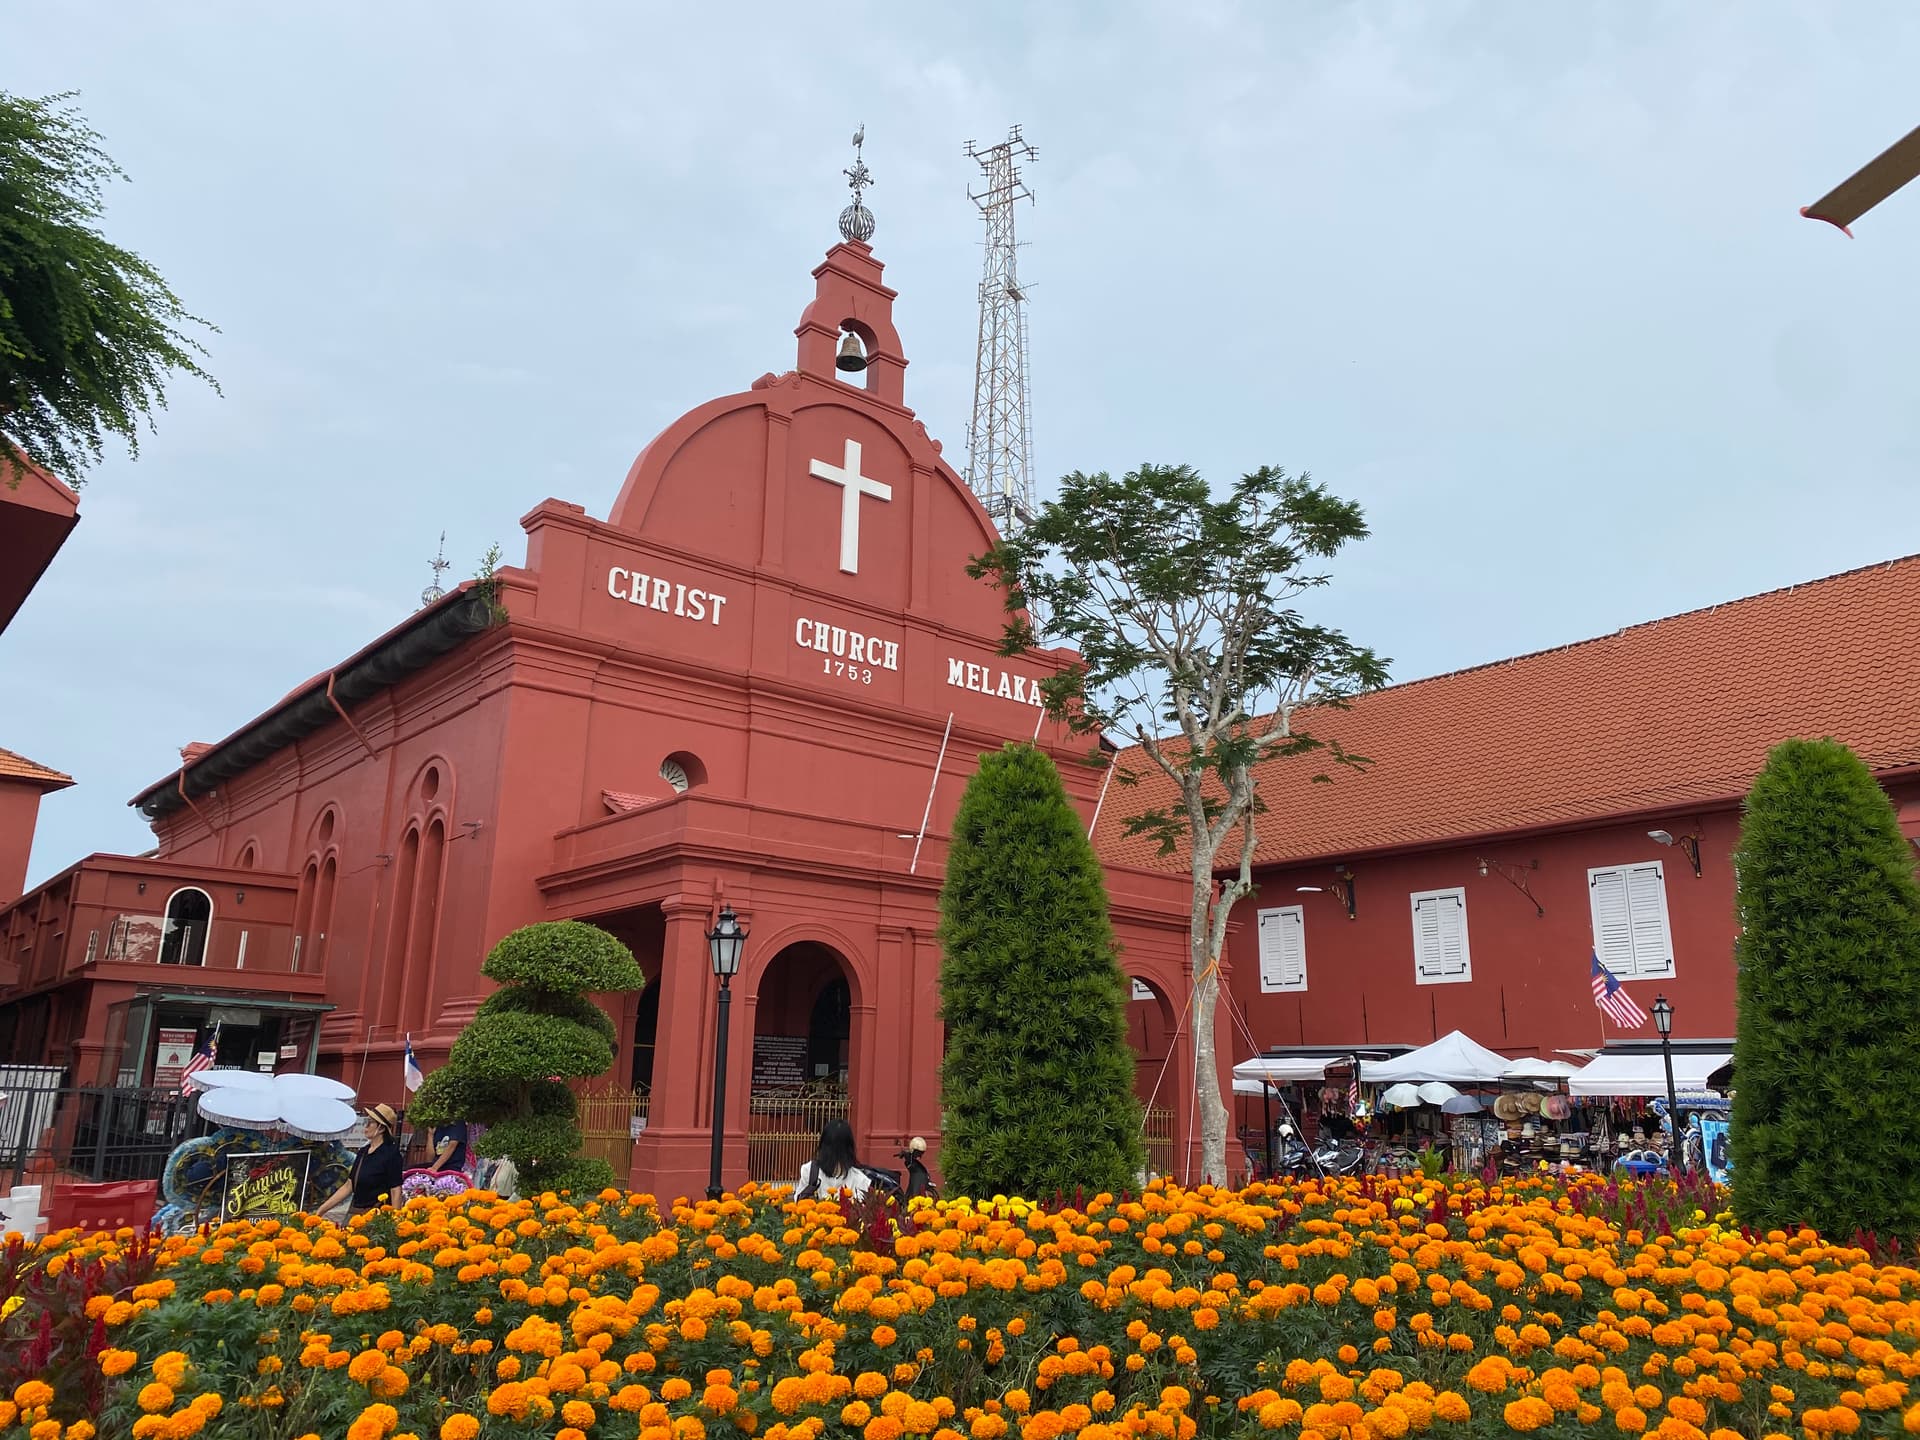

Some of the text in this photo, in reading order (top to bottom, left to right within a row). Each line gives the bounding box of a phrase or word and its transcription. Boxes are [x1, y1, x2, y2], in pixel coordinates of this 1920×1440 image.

[607, 566, 727, 625] CHRIST
[796, 617, 899, 671] CHURCH
[823, 658, 872, 685] 1753
[947, 657, 1044, 708] MELAKA
[227, 1167, 294, 1217] Flaming
